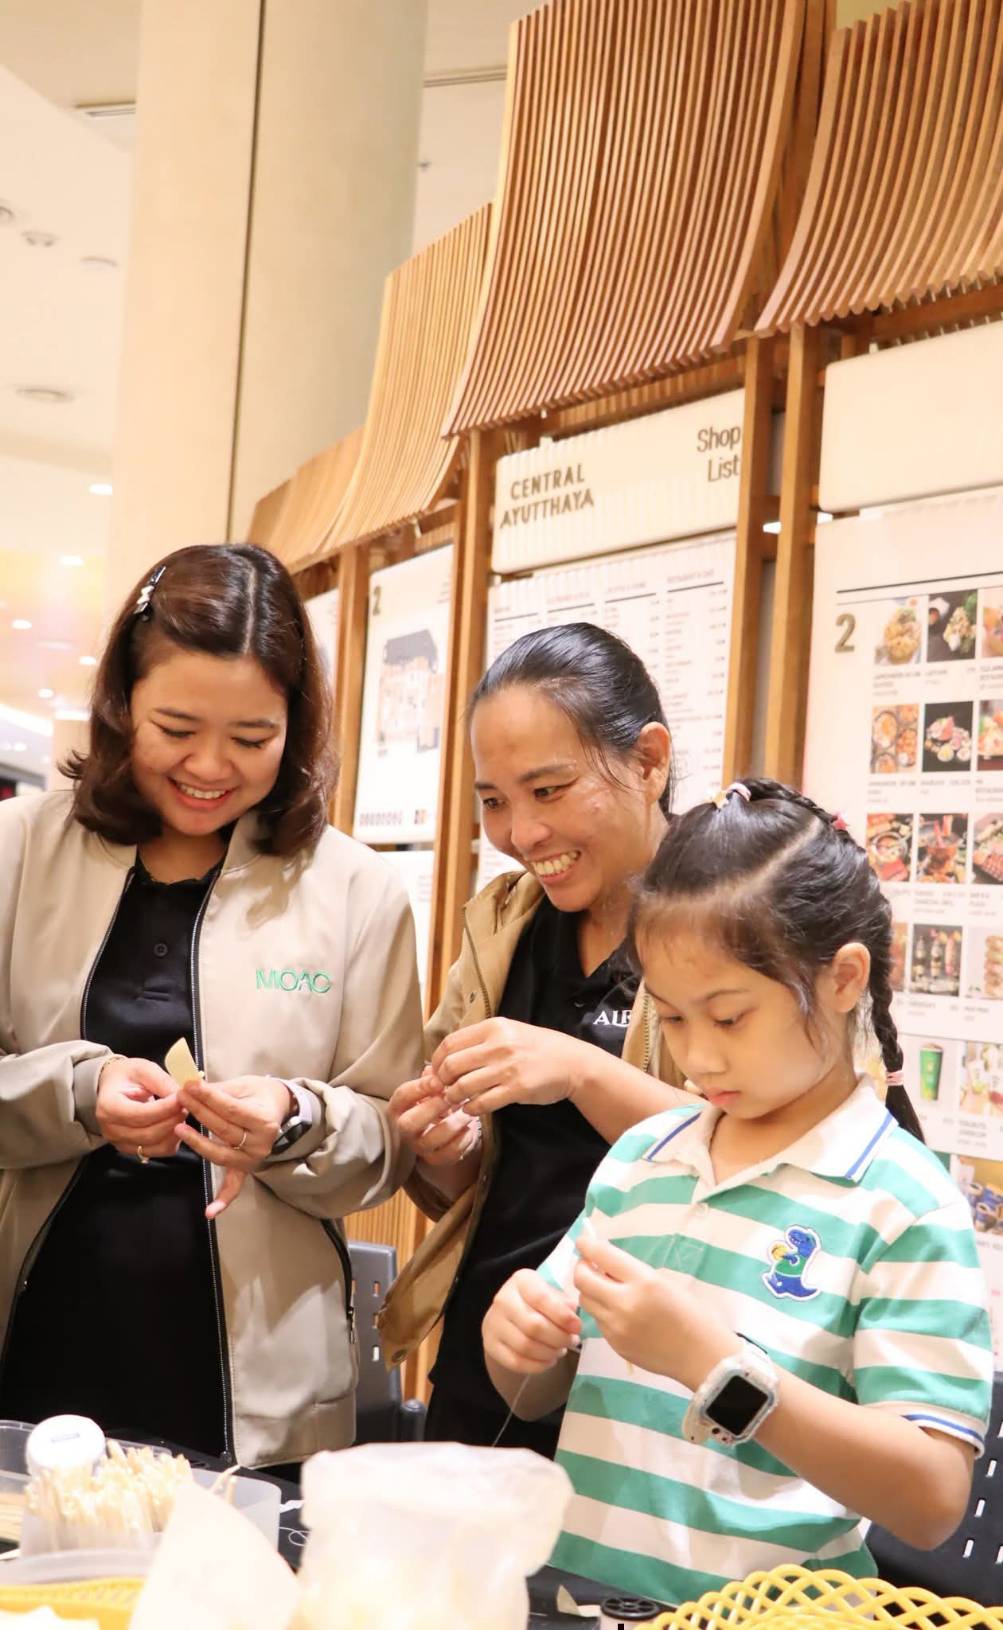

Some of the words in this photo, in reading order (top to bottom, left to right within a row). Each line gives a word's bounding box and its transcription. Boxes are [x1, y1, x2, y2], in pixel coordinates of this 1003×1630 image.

[697, 425, 741, 453] Shop
[510, 462, 585, 500] CENTRAL
[707, 454, 740, 483] List
[500, 488, 595, 529] AYUTTHAYA
[834, 612, 856, 653] 2
[255, 967, 332, 994] MOAC
